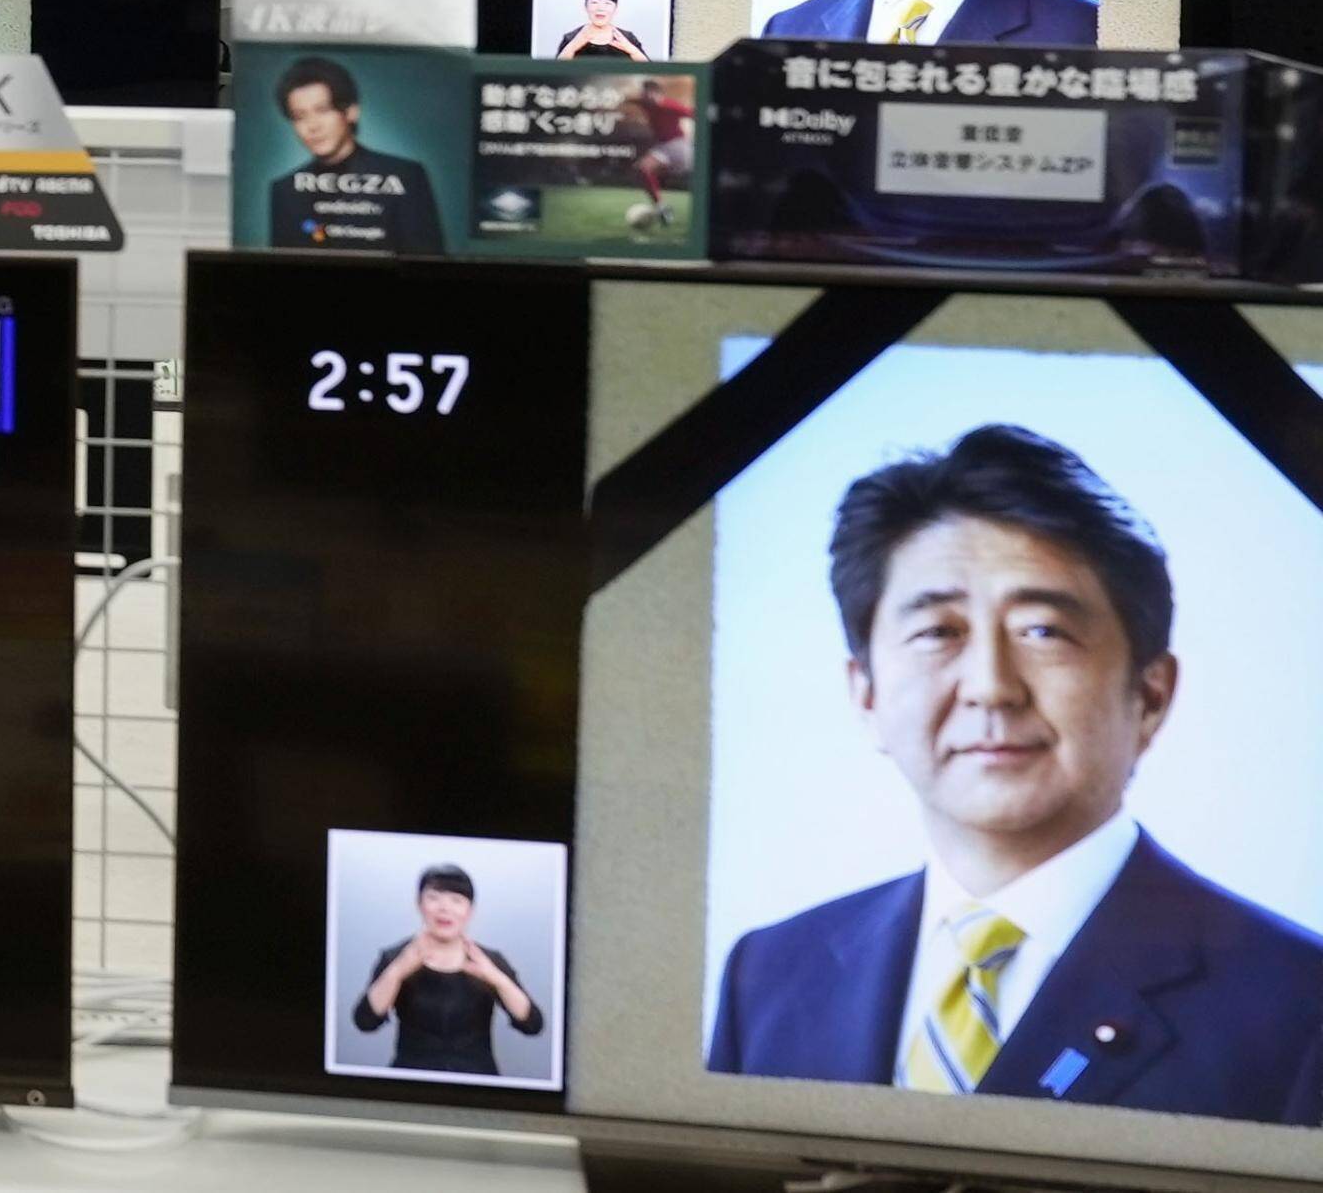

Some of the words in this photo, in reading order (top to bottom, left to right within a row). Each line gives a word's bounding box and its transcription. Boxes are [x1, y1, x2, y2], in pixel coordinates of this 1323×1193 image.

[783, 56, 1198, 103] 音に包まれる豊かな臨場感
[788, 109, 856, 135] Dolby
[294, 173, 405, 195] REGZA
[32, 225, 111, 242] TOSHIBA
[308, 350, 469, 415] 2:57
